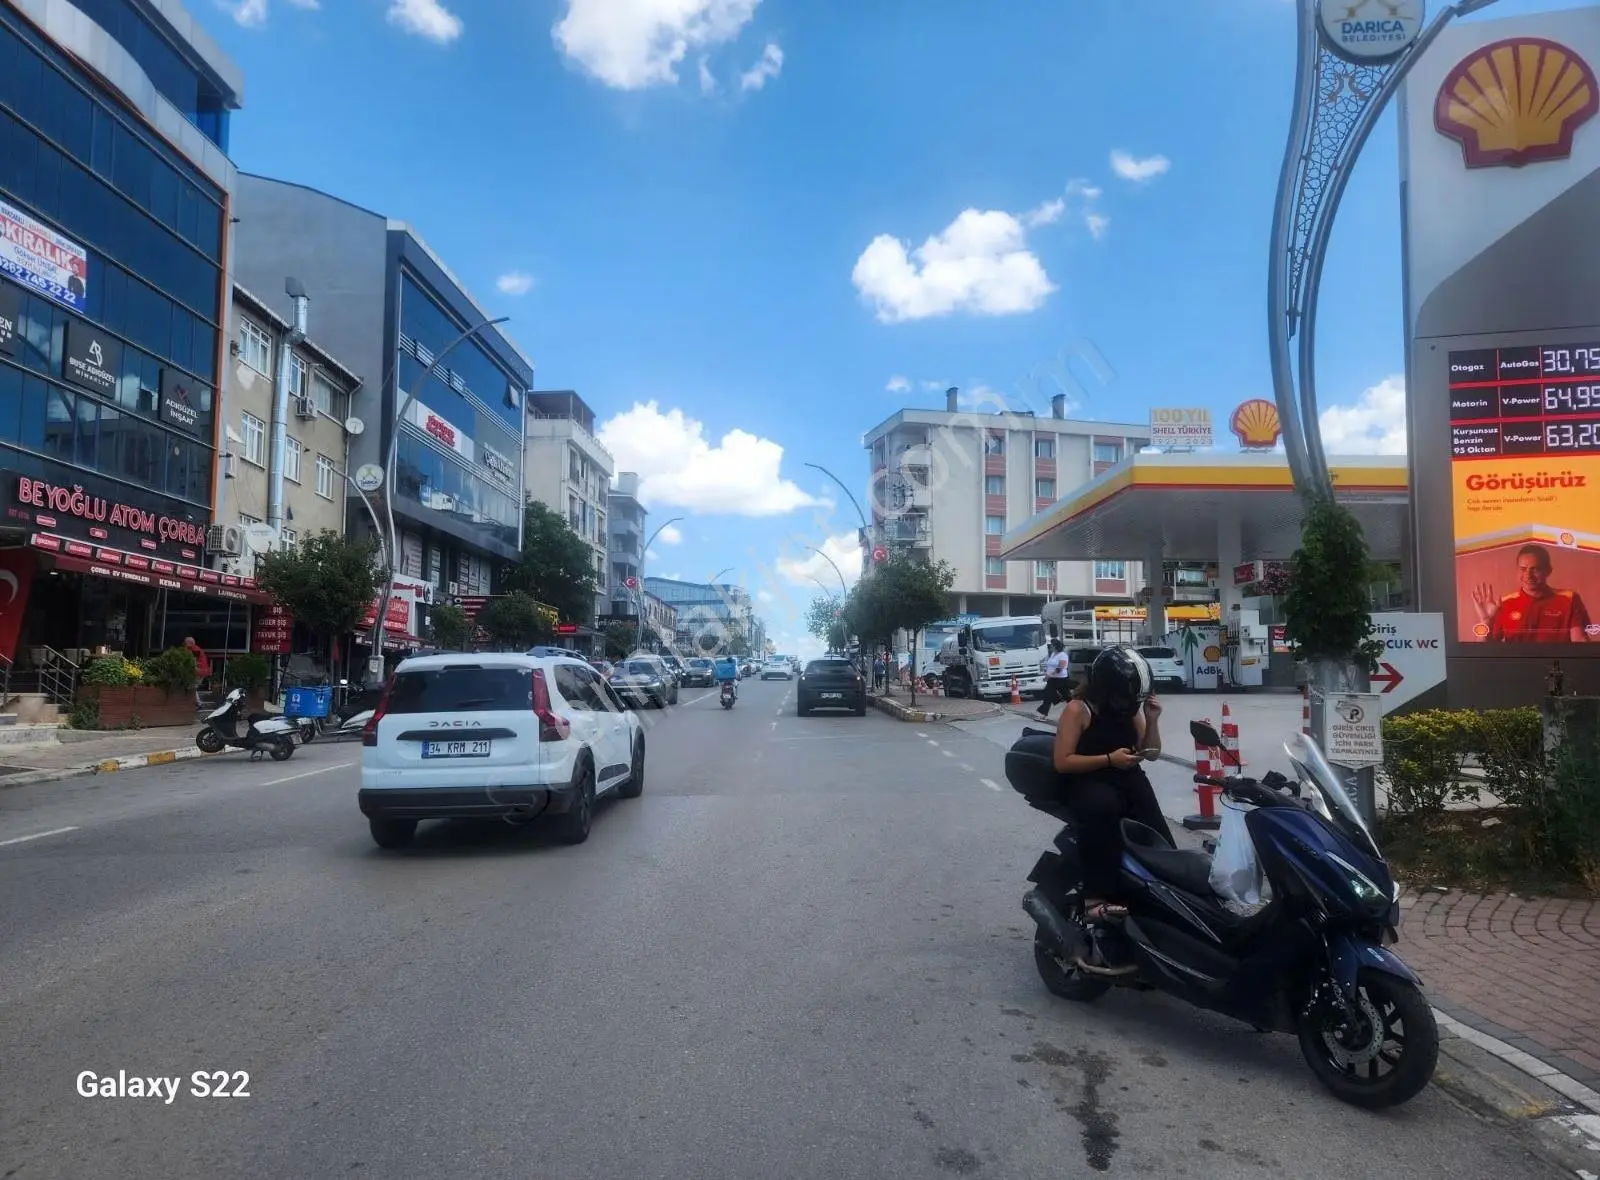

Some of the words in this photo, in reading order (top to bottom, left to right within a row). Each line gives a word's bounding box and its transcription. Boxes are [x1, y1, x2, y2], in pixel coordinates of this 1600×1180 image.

[1342, 20, 1404, 33] DARICA
[25, 269, 47, 288] 745
[48, 281, 62, 295] 22
[63, 291, 77, 304] 22
[1451, 364, 1485, 372] Otogaz
[1500, 360, 1539, 369] AutoGas
[1452, 399, 1487, 408] Motorin
[1502, 397, 1541, 405] V-Power
[1152, 426, 1176, 435] SHELL
[1178, 425, 1212, 435] TÜRKİYE
[1453, 437, 1484, 445] Benzin
[1504, 435, 1542, 443] V-Power
[1467, 446, 1496, 454] Oktan
[1466, 471, 1586, 494] Görüşürüz
[19, 476, 107, 522] BEYOĞLU
[109, 503, 155, 534] ATOM
[158, 516, 205, 546] ÇORBA
[1417, 639, 1438, 649] WC
[428, 720, 482, 728] DACIA
[430, 743, 441, 754] 34
[447, 742, 466, 753] KRM
[472, 741, 488, 753] 211
